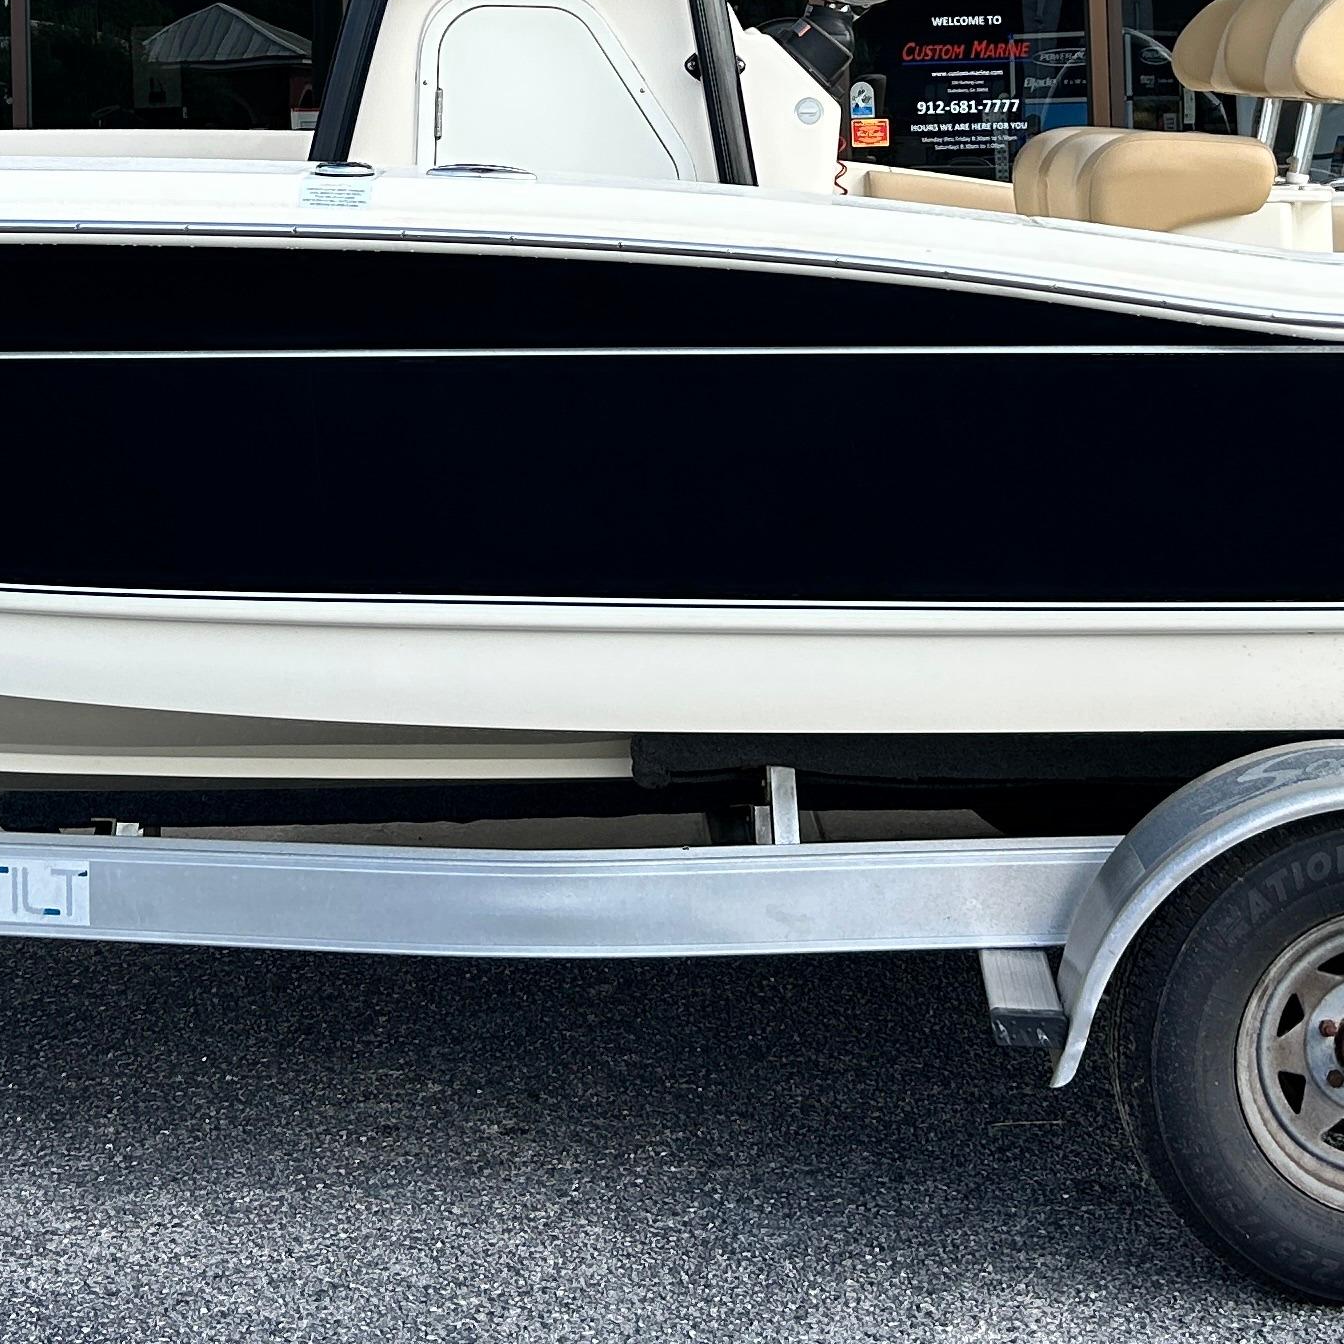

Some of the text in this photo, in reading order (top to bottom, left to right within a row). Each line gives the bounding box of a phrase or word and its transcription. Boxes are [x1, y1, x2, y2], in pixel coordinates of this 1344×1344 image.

[931, 15, 1002, 27] WELCOME TO
[901, 39, 1032, 62] CUSTOM MARINE
[916, 99, 1020, 115] 912-681-7777
[939, 123, 953, 131] WE
[954, 122, 970, 131] ARE
[971, 122, 992, 131] HERE
[992, 122, 1009, 130] FOR
[1009, 121, 1028, 130] YOU
